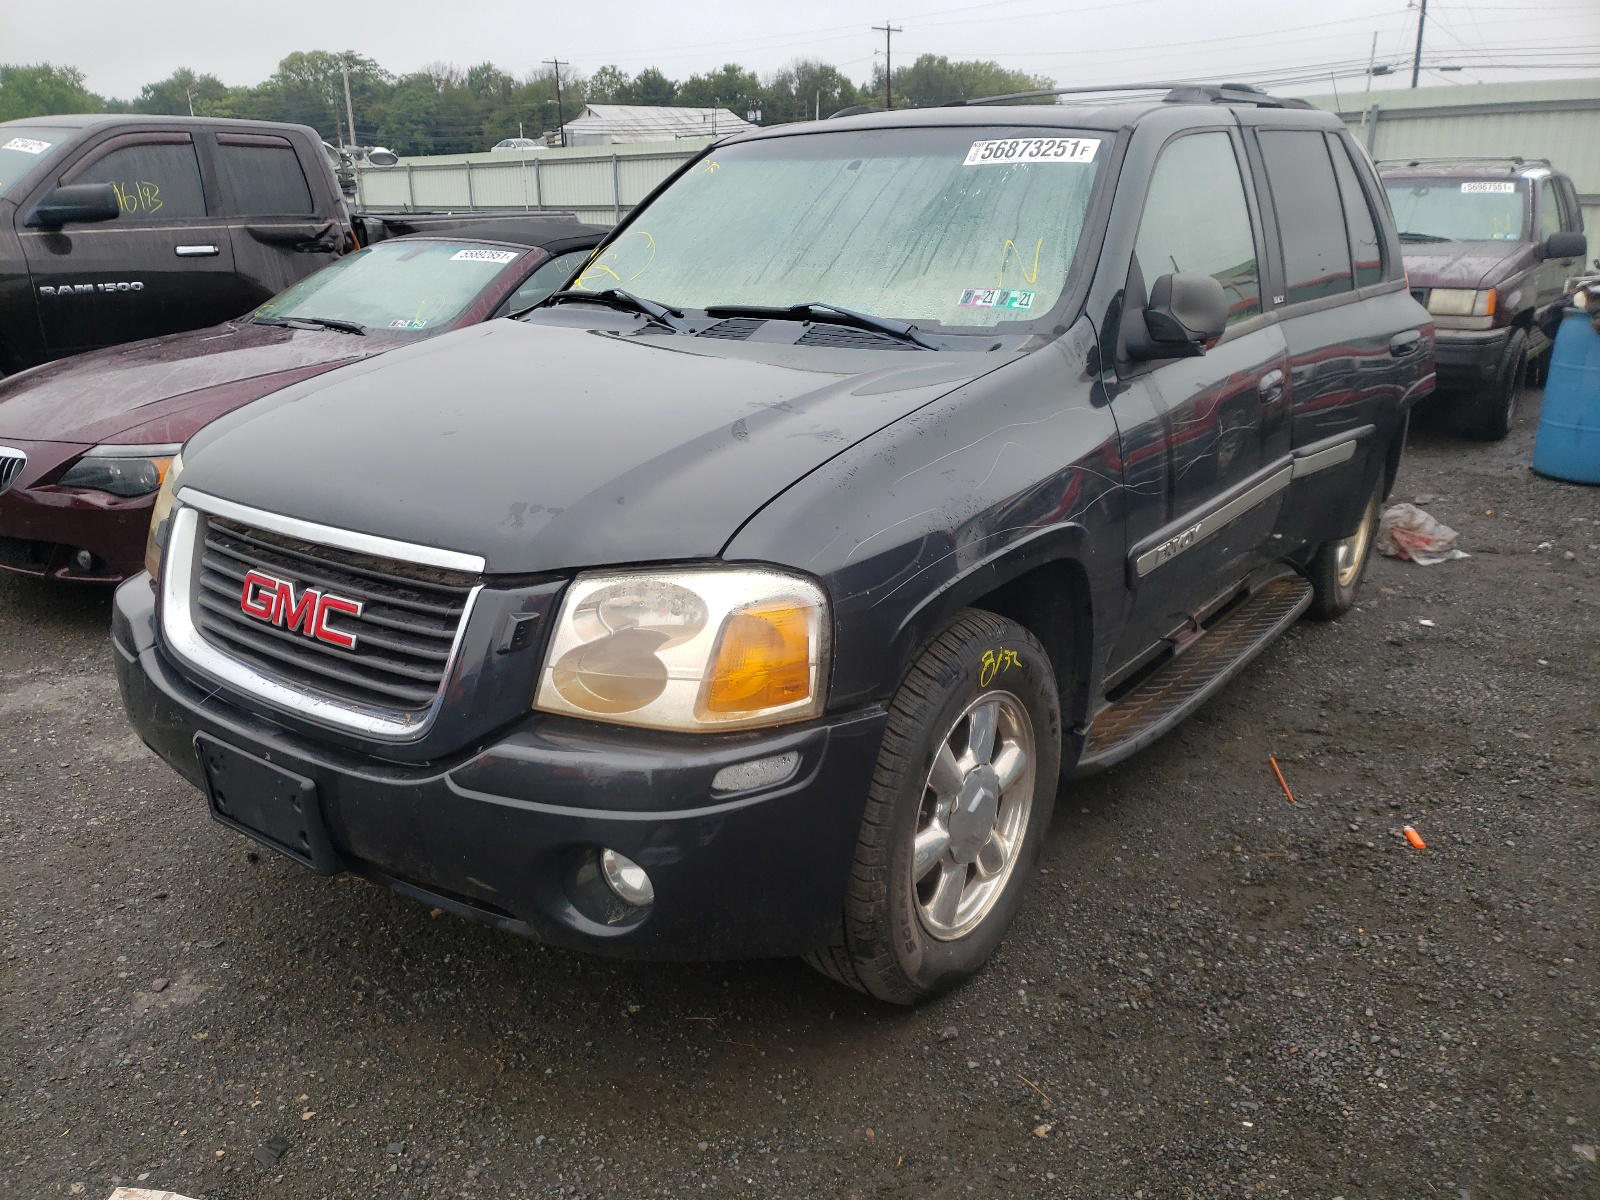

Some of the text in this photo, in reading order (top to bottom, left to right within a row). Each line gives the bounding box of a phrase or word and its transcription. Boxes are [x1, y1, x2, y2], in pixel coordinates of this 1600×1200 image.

[981, 140, 1080, 159] 56873251
[1080, 146, 1090, 155] F
[40, 281, 144, 297] RAM 1500
[982, 290, 995, 304] 21
[1019, 292, 1032, 307] 21
[241, 569, 363, 651] GMC
